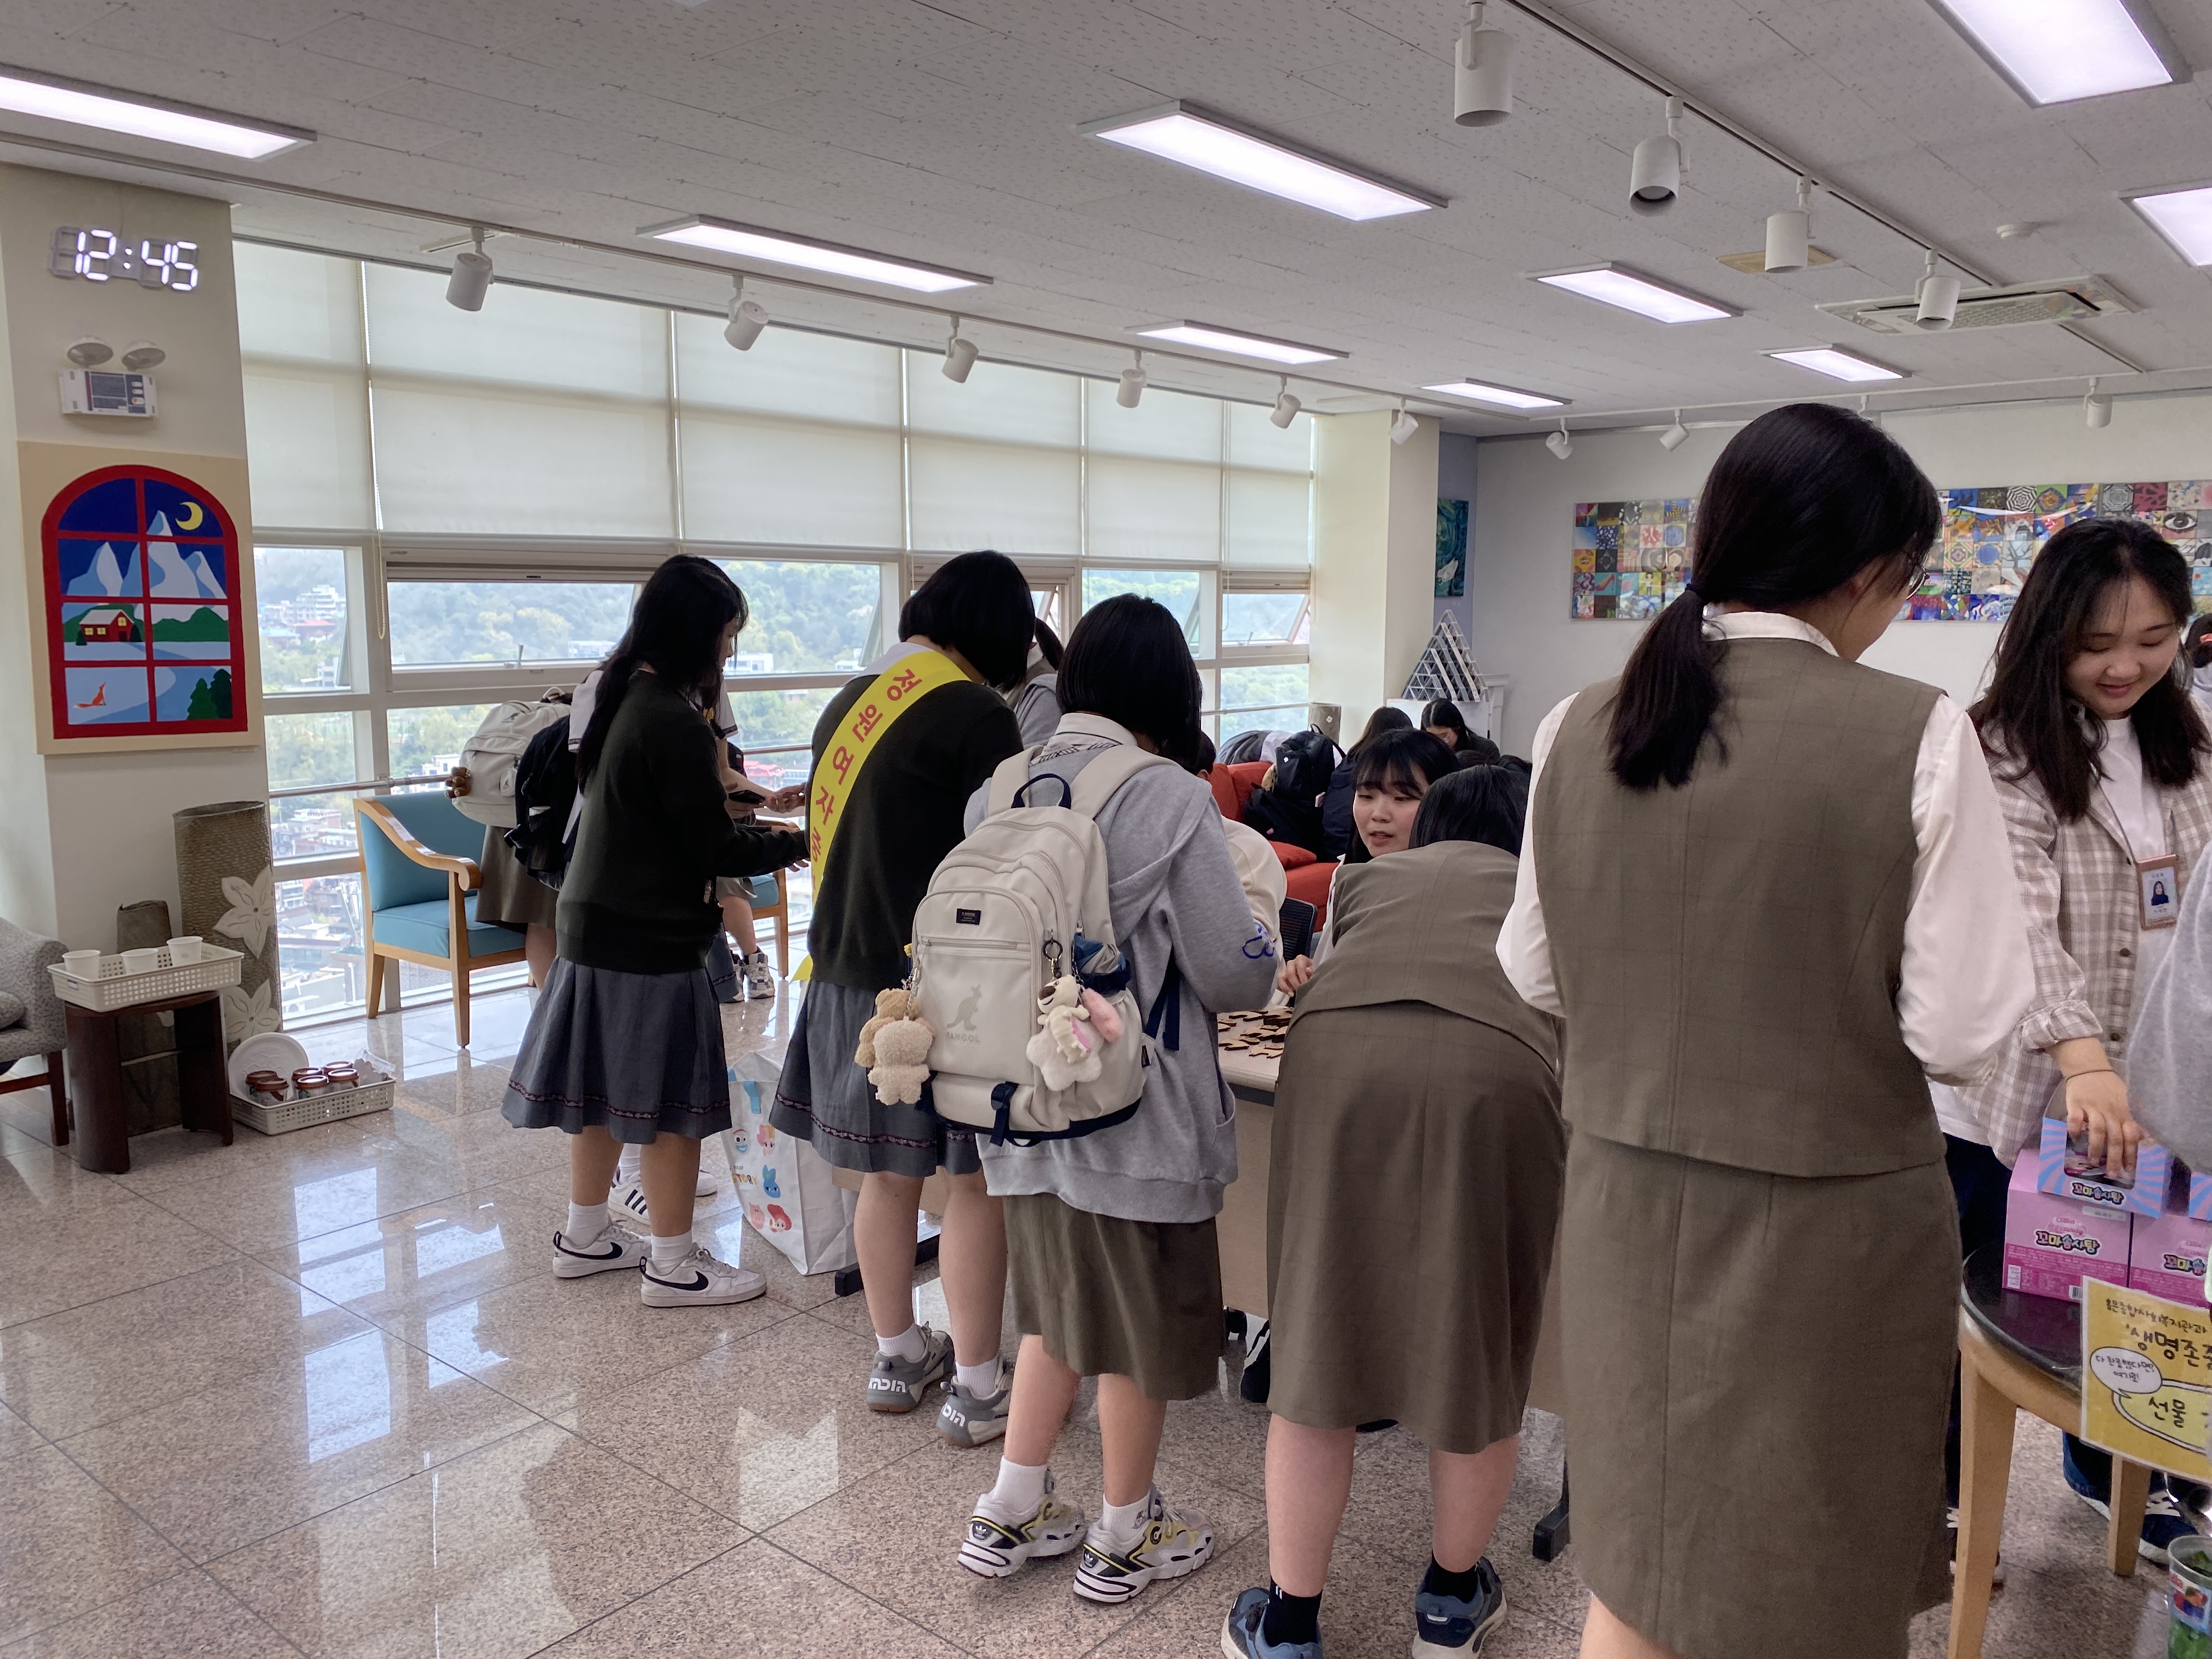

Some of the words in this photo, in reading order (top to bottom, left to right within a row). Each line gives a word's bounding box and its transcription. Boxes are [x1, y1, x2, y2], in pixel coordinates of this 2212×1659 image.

[75, 228, 199, 291] 12:45
[2036, 1231, 2101, 1255] 꼬마솜사탕
[2148, 1396, 2186, 1428] 선물
